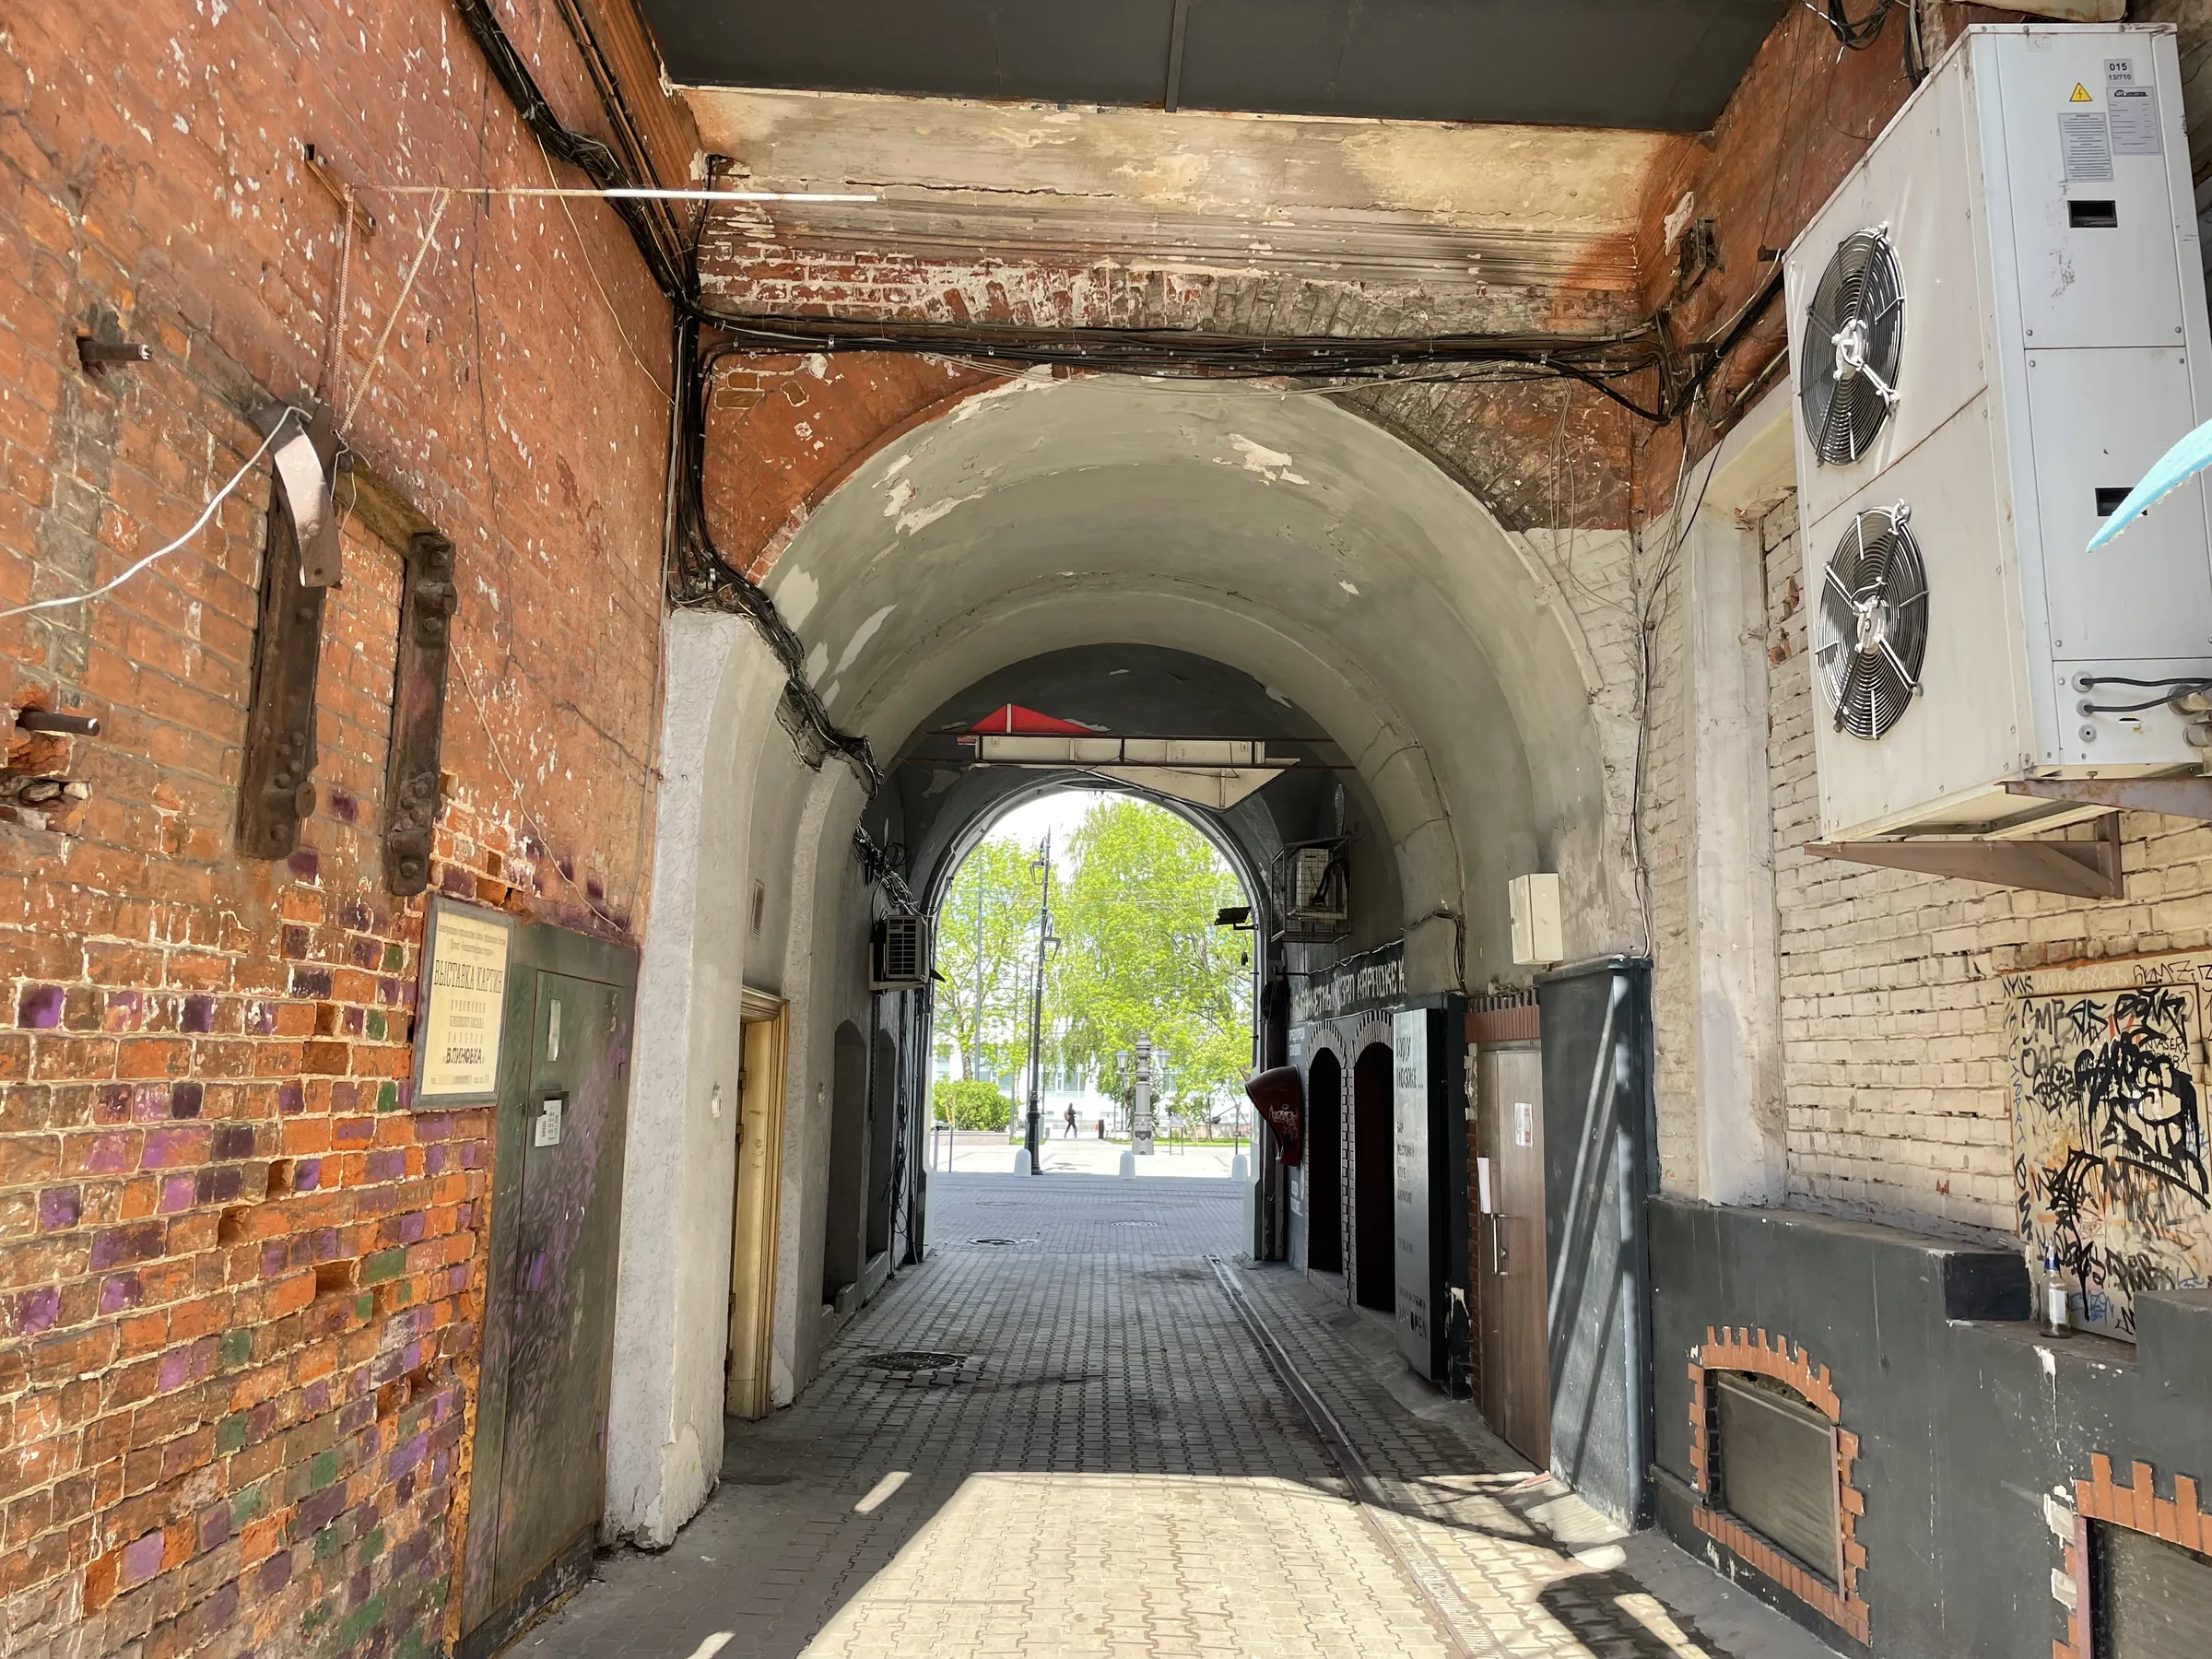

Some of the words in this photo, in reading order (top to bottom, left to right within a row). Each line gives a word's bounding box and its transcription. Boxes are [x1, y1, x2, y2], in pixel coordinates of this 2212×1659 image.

[2109, 63, 2128, 71] 015
[434, 959, 475, 990] ВЫСТАВКА
[476, 967, 503, 994] КАРТИН
[1357, 960, 1397, 1000] КАРАОКЕ
[1410, 1311, 1428, 1339] OPEN
